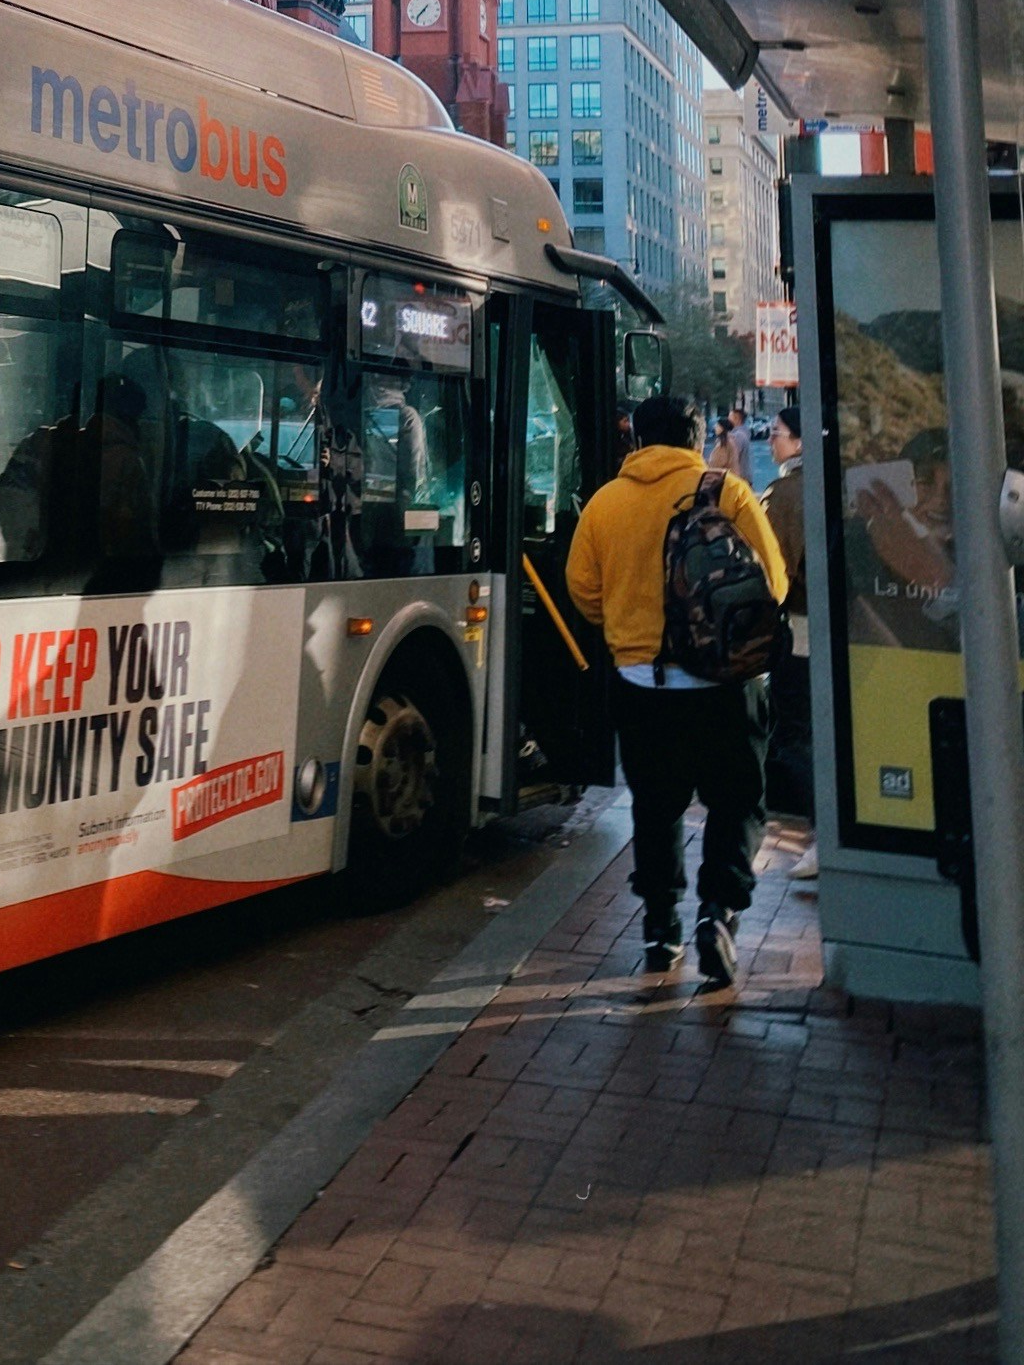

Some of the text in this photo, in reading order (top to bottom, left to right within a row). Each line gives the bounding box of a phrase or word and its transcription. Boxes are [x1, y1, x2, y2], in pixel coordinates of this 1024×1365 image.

[31, 65, 288, 197] metrobus
[402, 309, 449, 338] SQUARE
[874, 575, 898, 597] La
[7, 627, 98, 720] KEEP
[107, 620, 192, 706] YOUR
[135, 699, 212, 787] SAFE
[883, 770, 910, 792] ad
[78, 808, 167, 838] Submit information
